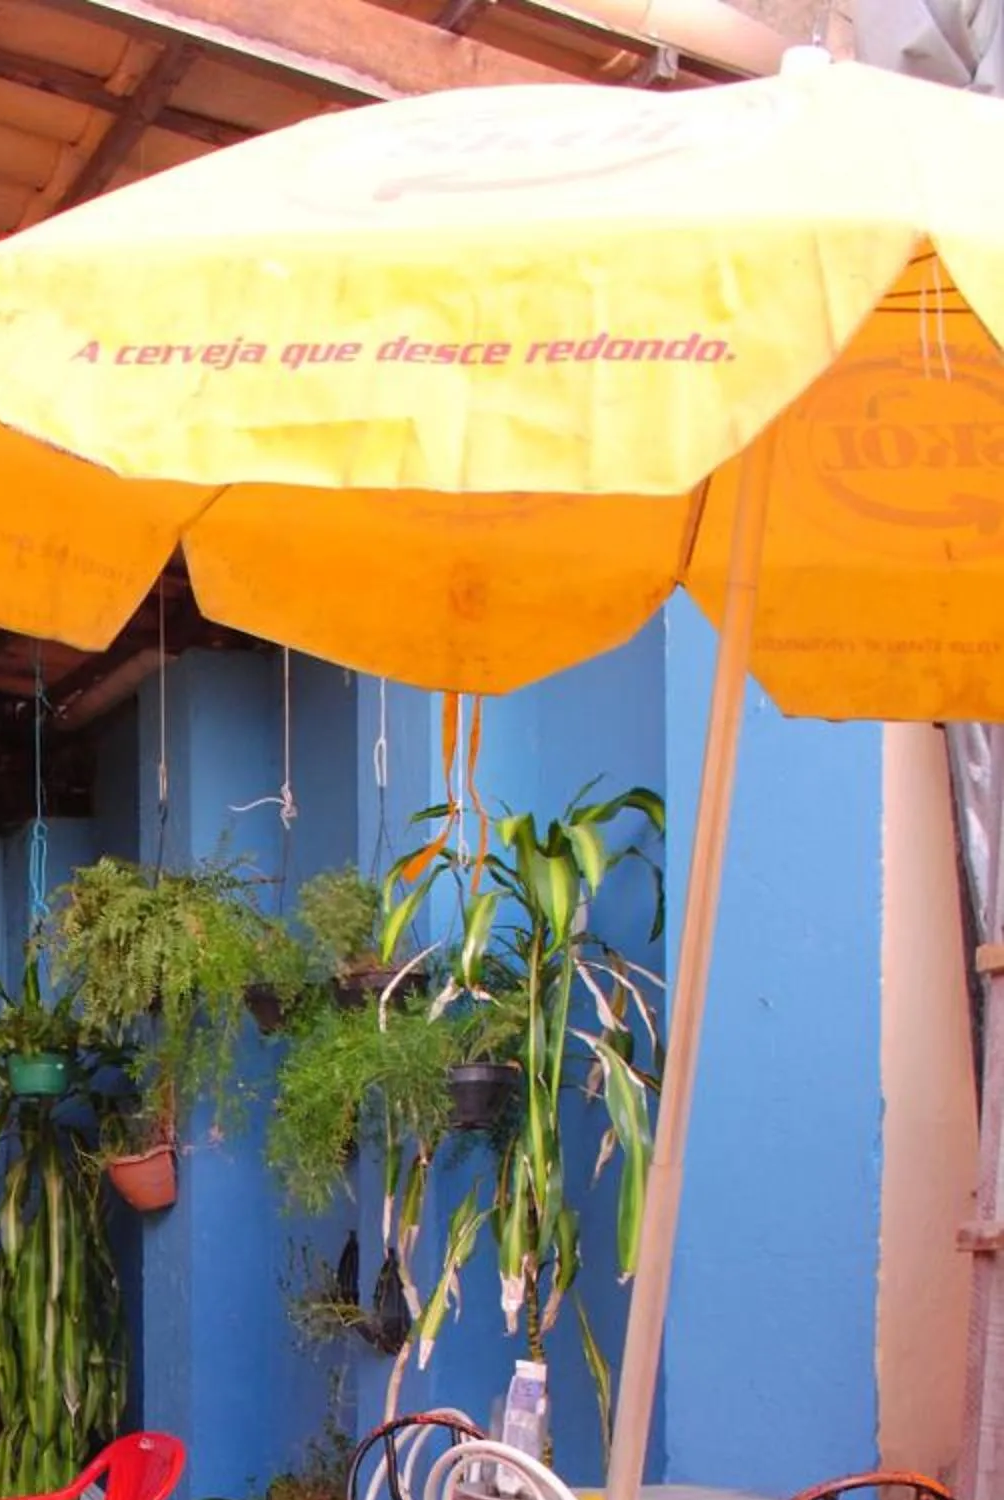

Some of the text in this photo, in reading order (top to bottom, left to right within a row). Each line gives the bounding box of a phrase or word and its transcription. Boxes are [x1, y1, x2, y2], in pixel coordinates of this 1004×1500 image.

[70, 331, 737, 371] A cerveja que desce redondo.
